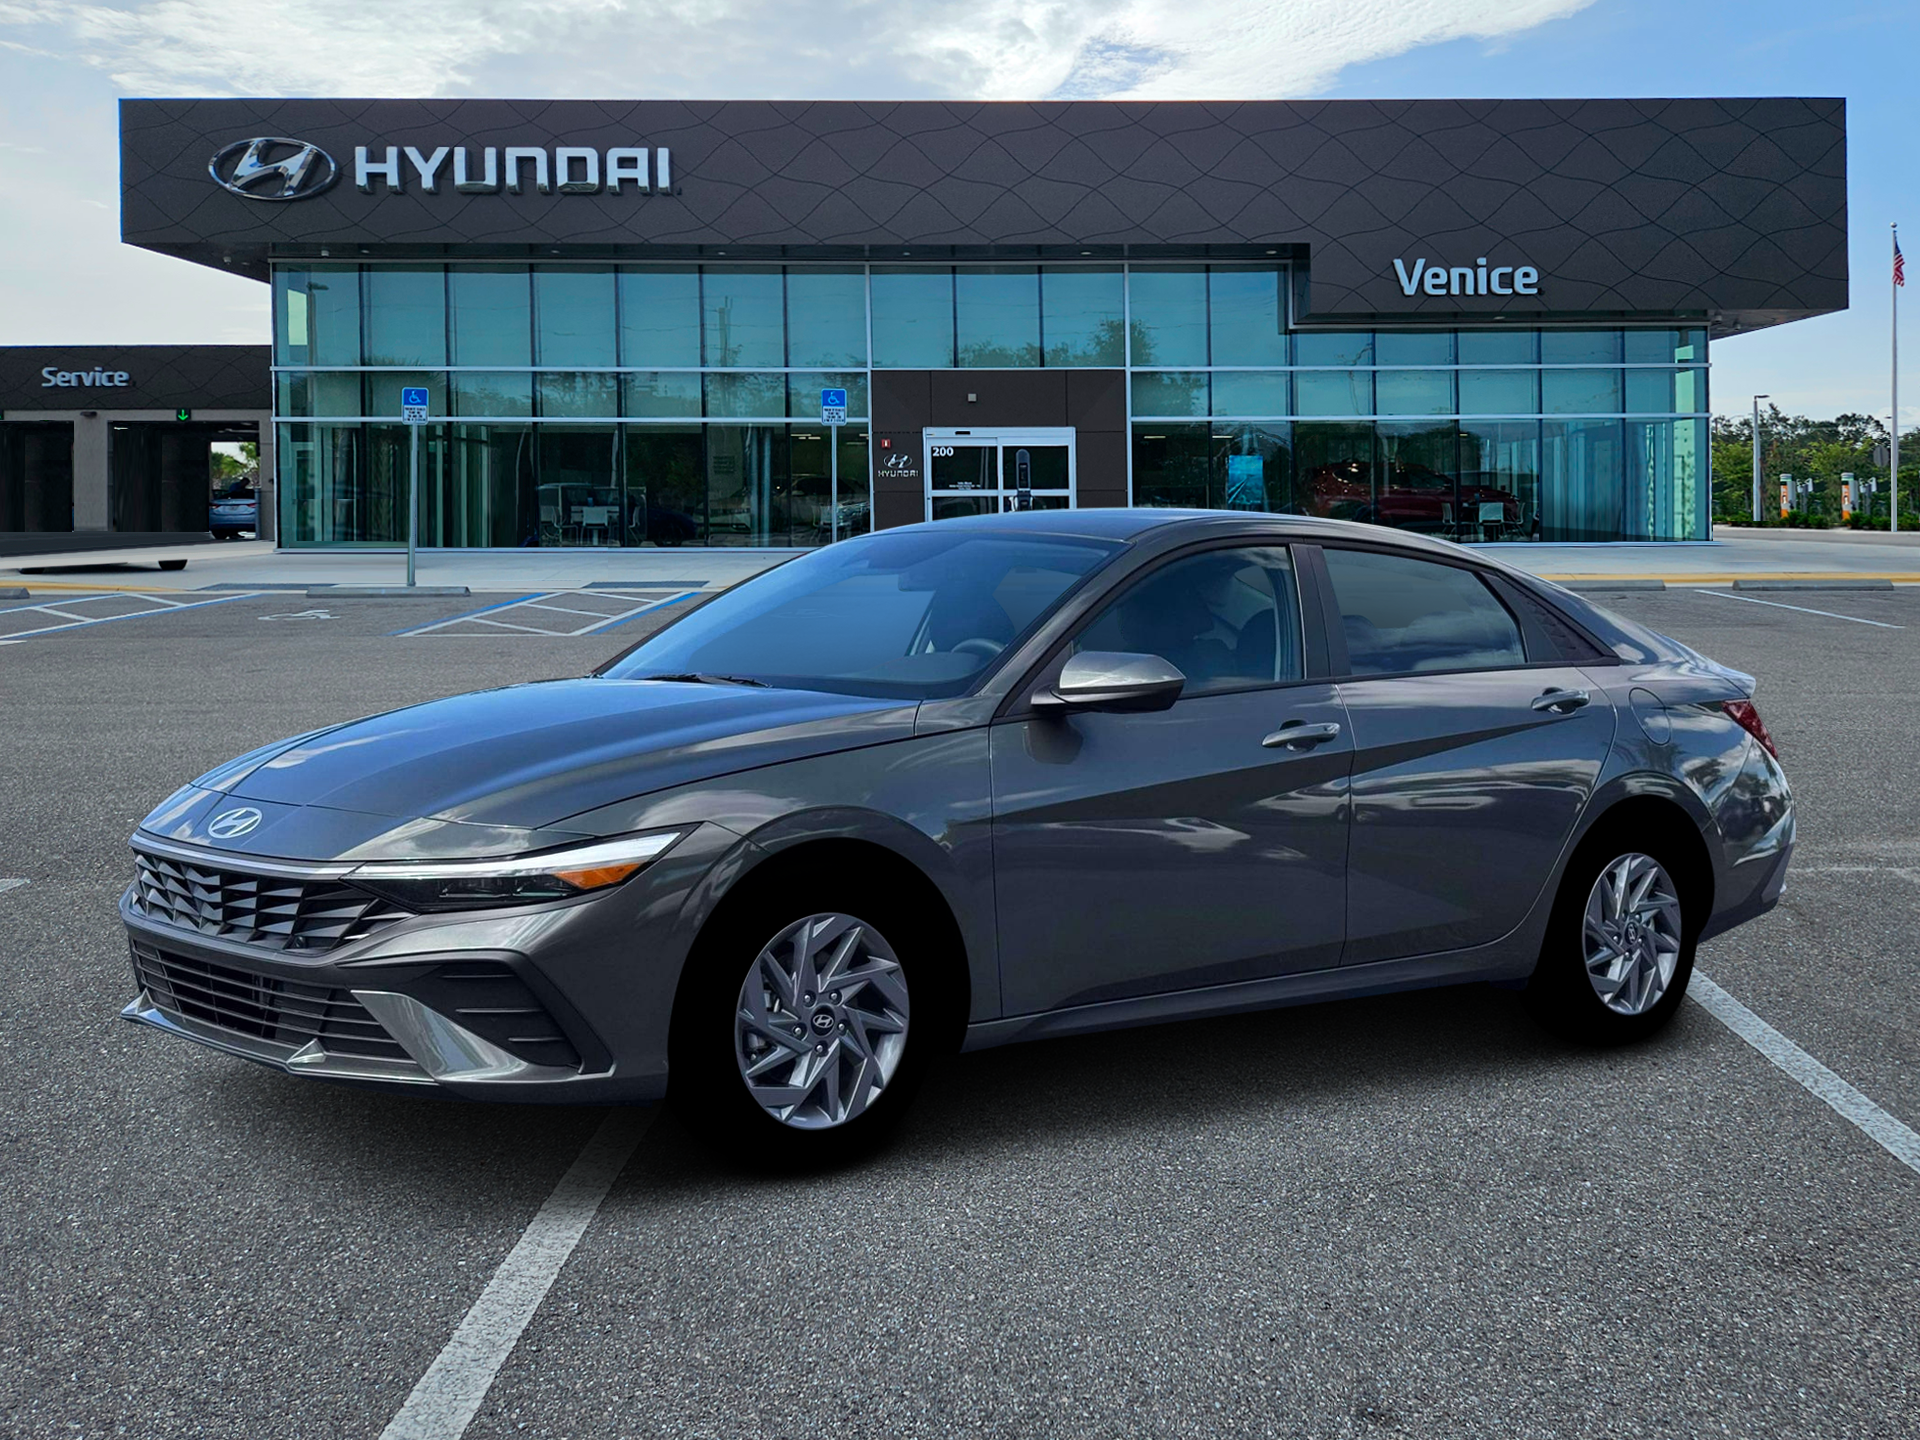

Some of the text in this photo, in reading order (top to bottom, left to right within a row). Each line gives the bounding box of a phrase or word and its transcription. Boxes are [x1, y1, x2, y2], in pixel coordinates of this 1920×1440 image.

[354, 146, 672, 195] HYUNDAI
[1392, 257, 1539, 296] Venice
[41, 366, 130, 387] Service
[932, 447, 954, 457] 200
